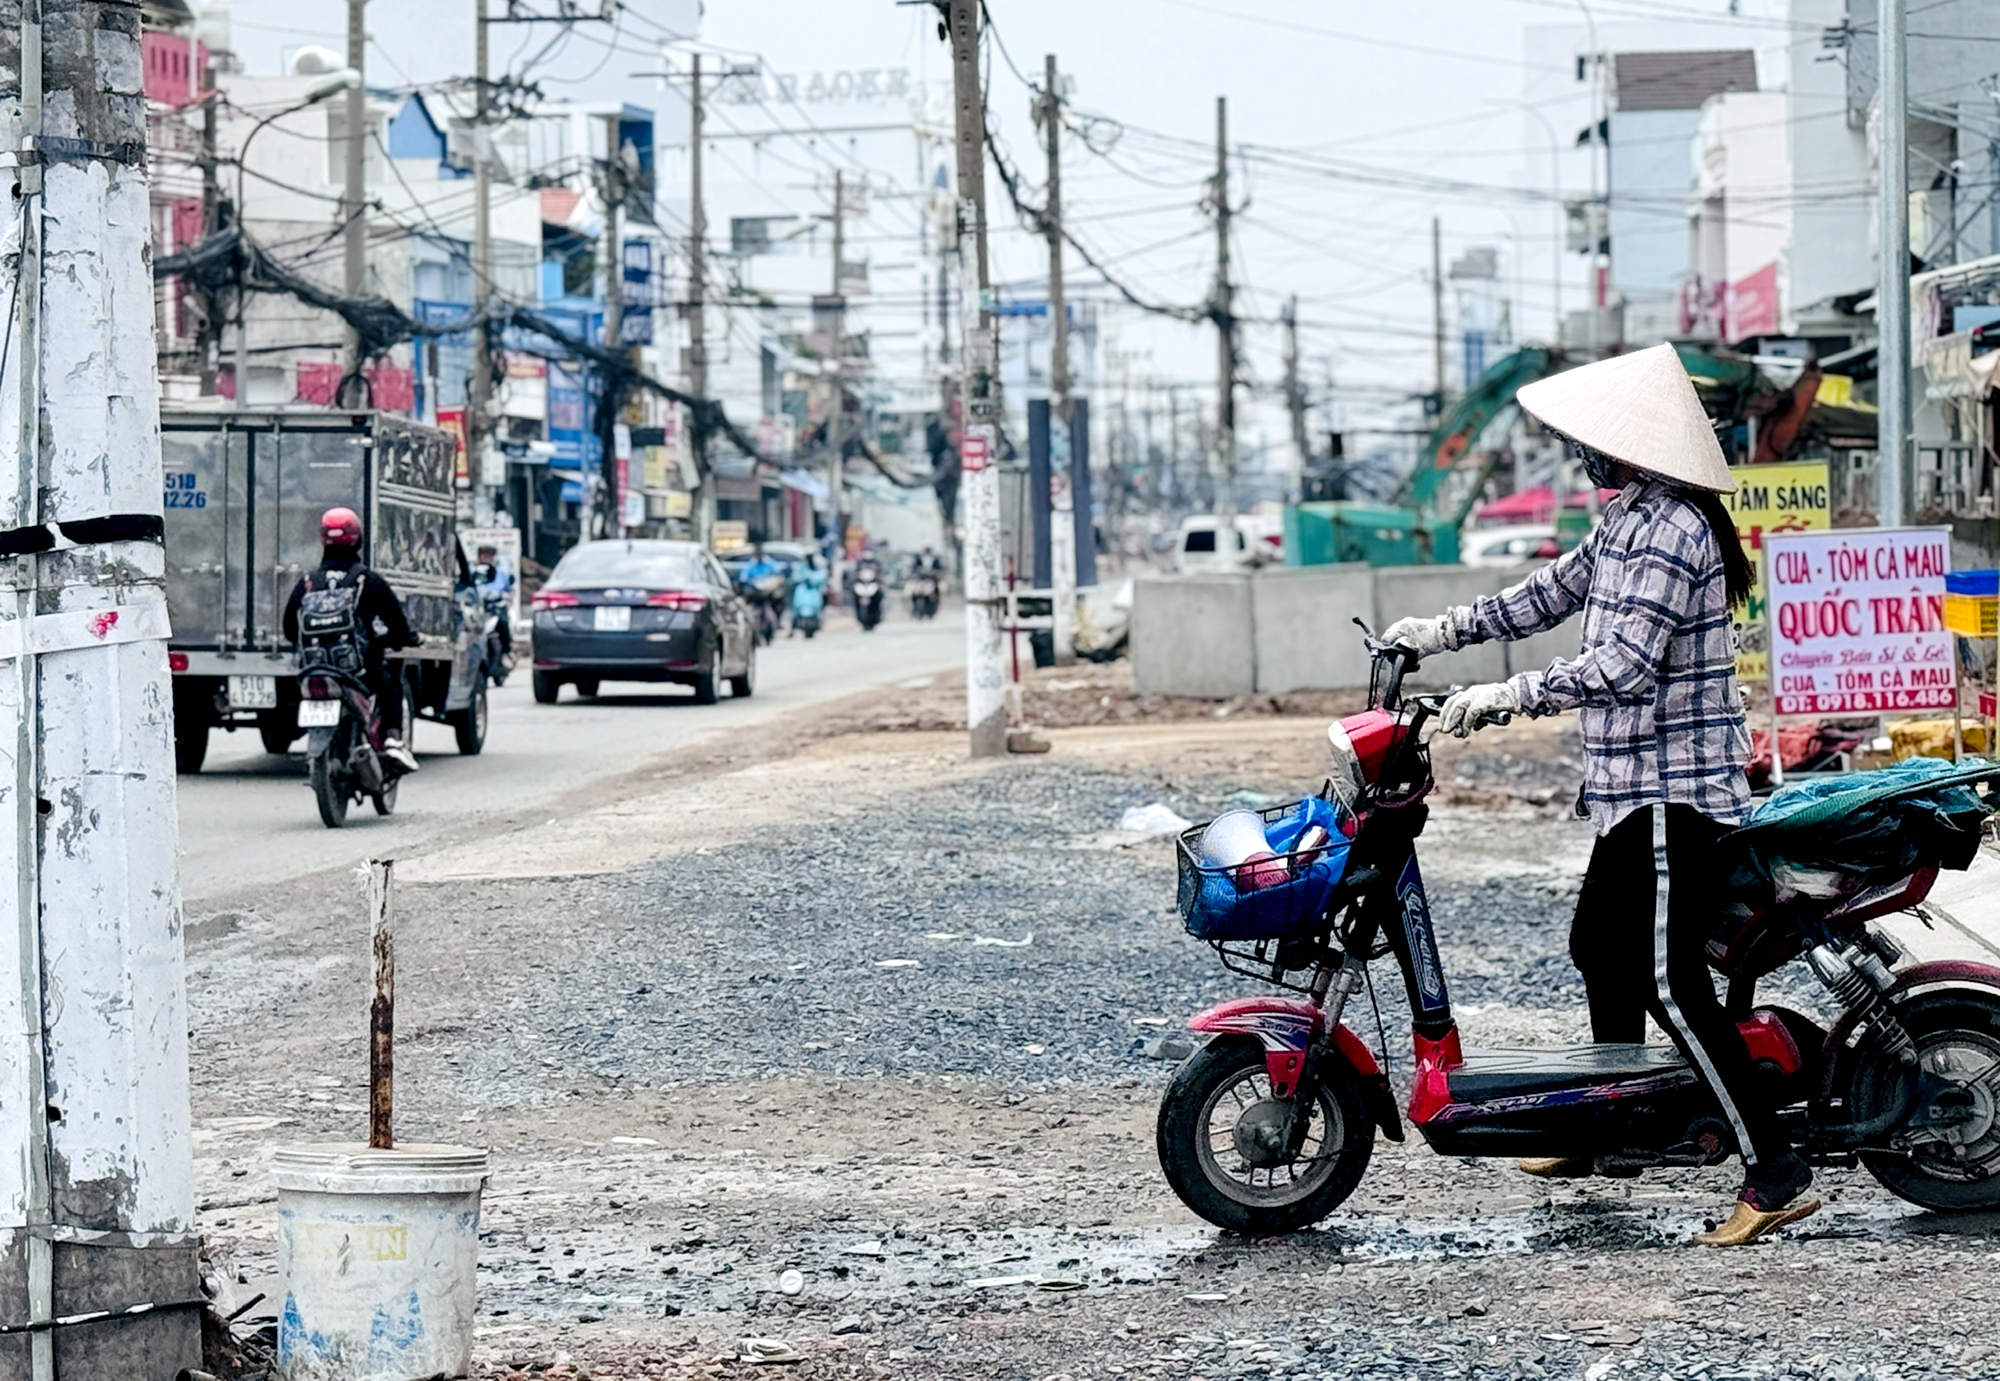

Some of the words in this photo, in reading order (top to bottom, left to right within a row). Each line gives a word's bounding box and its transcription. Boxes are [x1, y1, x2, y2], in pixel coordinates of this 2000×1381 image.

[1776, 478, 1826, 510] SÁNG
[1775, 552, 1811, 584] CUA
[1827, 541, 1868, 582] TÔM
[1875, 538, 1899, 580] CÀ
[1904, 543, 1944, 579] MAU
[1779, 587, 1863, 645] QUỐC
[1902, 646, 1916, 662] &
[1781, 675, 1816, 693] CUA
[1834, 669, 1873, 690] TÔM
[1880, 666, 1904, 688] CÀ
[1910, 667, 1951, 687] MAU
[1780, 695, 1813, 713] ĐT:
[1816, 688, 1953, 712] 0918.116.486
